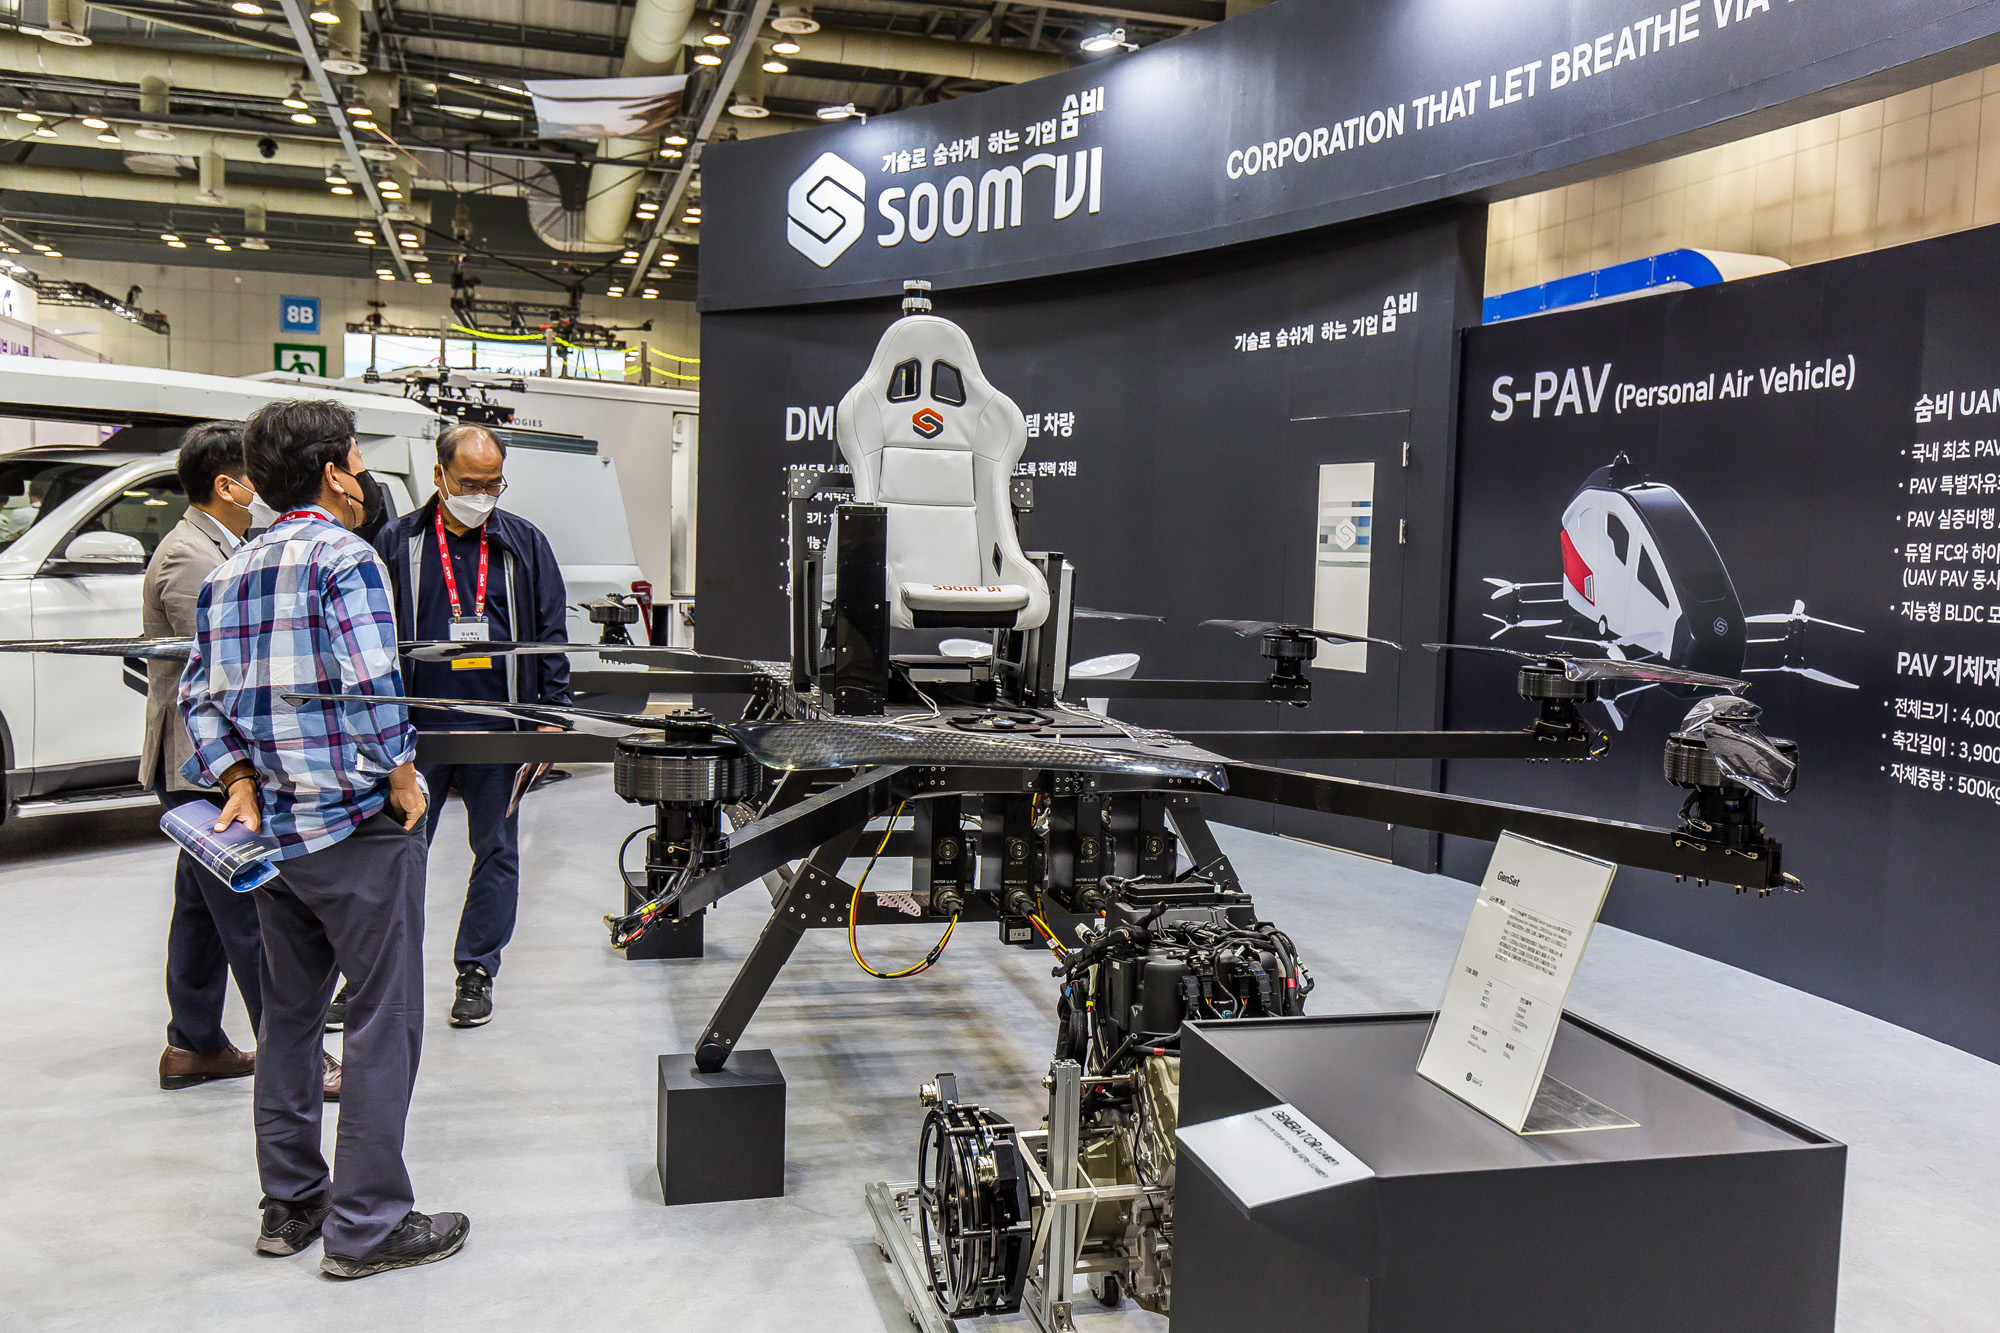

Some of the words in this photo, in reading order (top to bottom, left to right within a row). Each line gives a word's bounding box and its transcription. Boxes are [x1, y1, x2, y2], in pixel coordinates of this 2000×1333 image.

[1226, 104, 1405, 180] CORPORATION
[1412, 79, 1481, 131] THAT
[1488, 61, 1544, 110] LET
[1550, 0, 1702, 90] BREATHE
[881, 147, 927, 174] 기술로
[932, 135, 980, 168] 숨쉬게
[987, 129, 1020, 155] 하는
[1024, 119, 1057, 147] 기업
[1060, 86, 1105, 140] 숨비
[286, 304, 315, 325] 8B
[1234, 331, 1271, 352] 기술로
[1275, 324, 1314, 348] 숨쉬게
[1320, 320, 1347, 341] 하는
[1351, 314, 1379, 337] 기업
[1381, 291, 1418, 333] 숨비
[1490, 362, 1612, 422] S-PAV
[1614, 373, 1715, 414] (Personal
[1719, 369, 1754, 399] Air
[1759, 354, 1856, 394] Vehicle)
[1914, 390, 1954, 423] 숨비
[1043, 411, 1075, 437] 차량
[1911, 441, 1940, 464] 국내
[1942, 440, 1971, 461] 최초
[1038, 461, 1057, 477] 전력
[1058, 461, 1077, 477] 지원
[1909, 477, 1938, 495] PAV
[1940, 473, 2000, 496] 특별자유
[1907, 510, 1936, 528] PAV
[1938, 507, 1995, 530] 실증비행
[1904, 542, 1932, 564] 듀얼
[1935, 542, 1969, 564] FC와
[1971, 542, 2000, 564] 하이
[1902, 567, 1938, 588] (UAV
[1939, 569, 1969, 588] PAV
[1971, 569, 2000, 591] 동시
[1901, 600, 1941, 623] 지능형
[1944, 603, 1985, 623] BLDC
[1896, 651, 1938, 678] PAV
[1894, 697, 1949, 724] 전체크기
[1892, 729, 1946, 757] 축간길이
[1890, 763, 1946, 791] 자체중량
[1497, 870, 1520, 887] GenSet
[1272, 1110, 1322, 1148] GENERATOR
